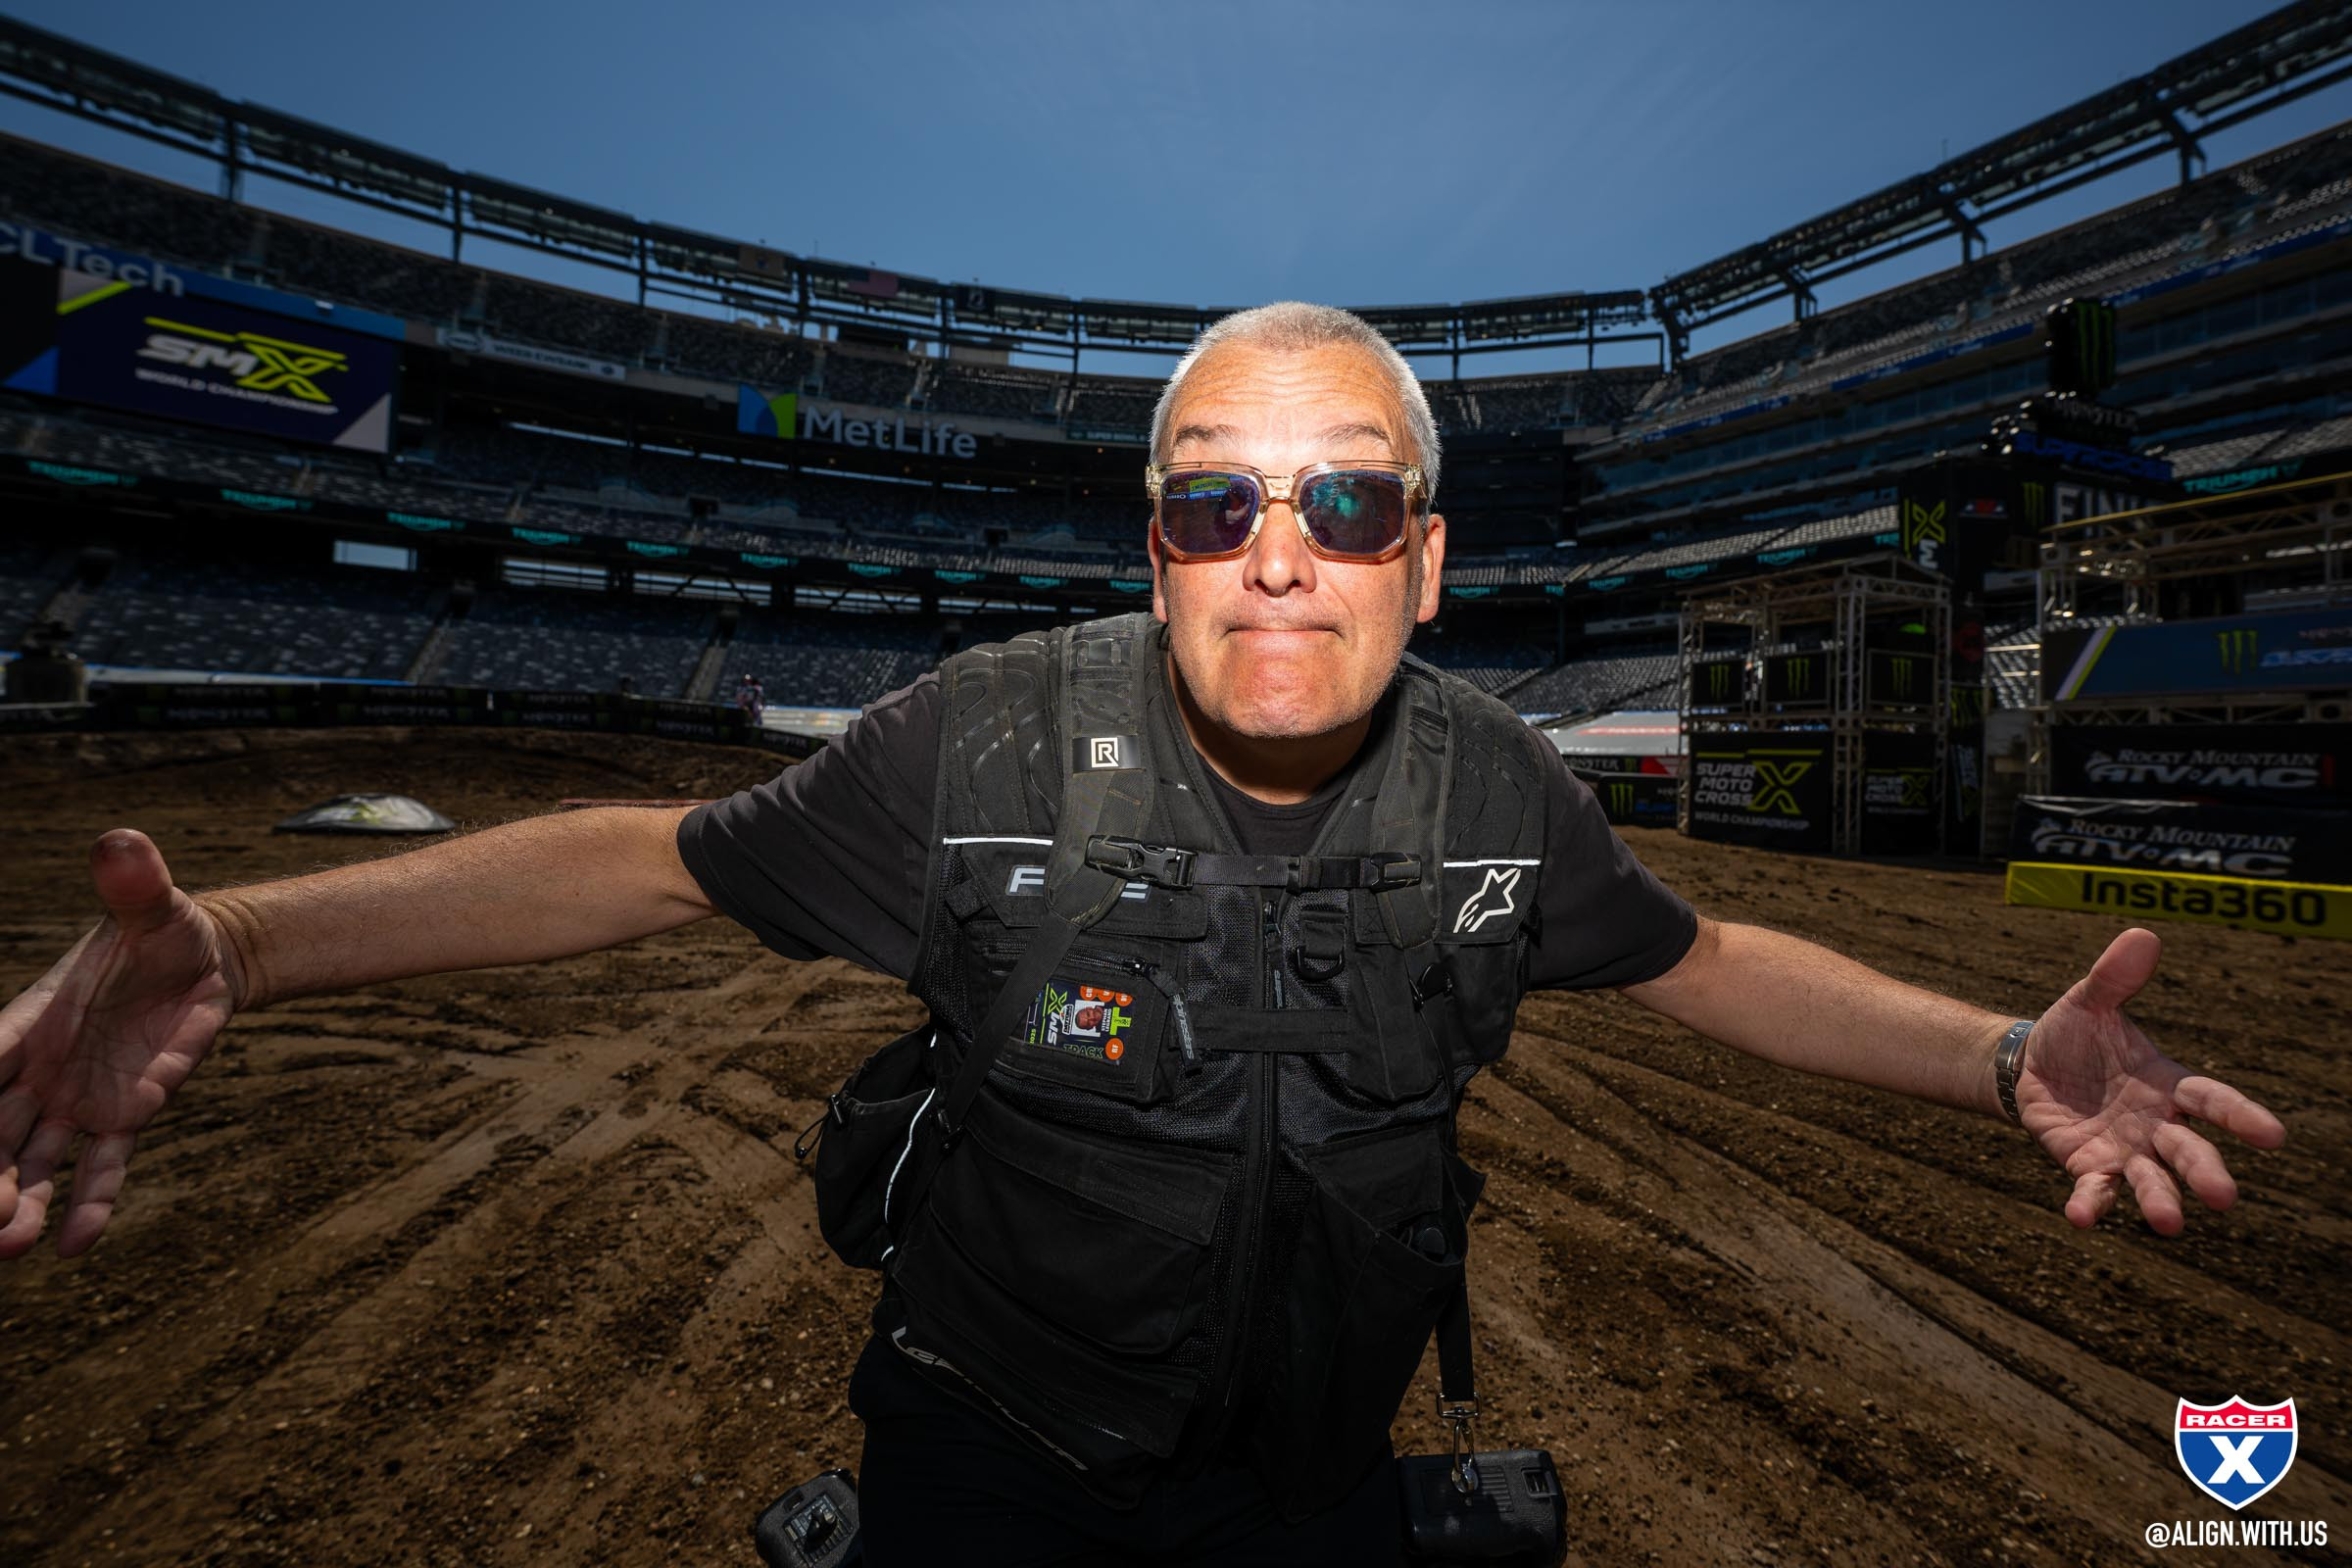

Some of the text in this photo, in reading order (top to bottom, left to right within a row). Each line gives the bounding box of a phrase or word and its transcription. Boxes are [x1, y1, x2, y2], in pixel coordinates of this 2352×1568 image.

[135, 332, 349, 403] SMX
[802, 405, 978, 459] MetLife
[2181, 464, 2278, 494] TRIUMPH
[1912, 501, 1946, 570] MX
[1695, 762, 1757, 778] SUPER
[2118, 748, 2322, 767] ROCKY MOUNTAIN
[1693, 791, 1753, 808] CROSS
[1698, 777, 1753, 792] MOTO
[1694, 810, 1811, 831] WORLD CHAMPIONSHIP
[2068, 817, 2297, 852] ROCKY MOUNTAIN
[2082, 872, 2327, 927] Insta360
[1047, 987, 1068, 1047] SMX
